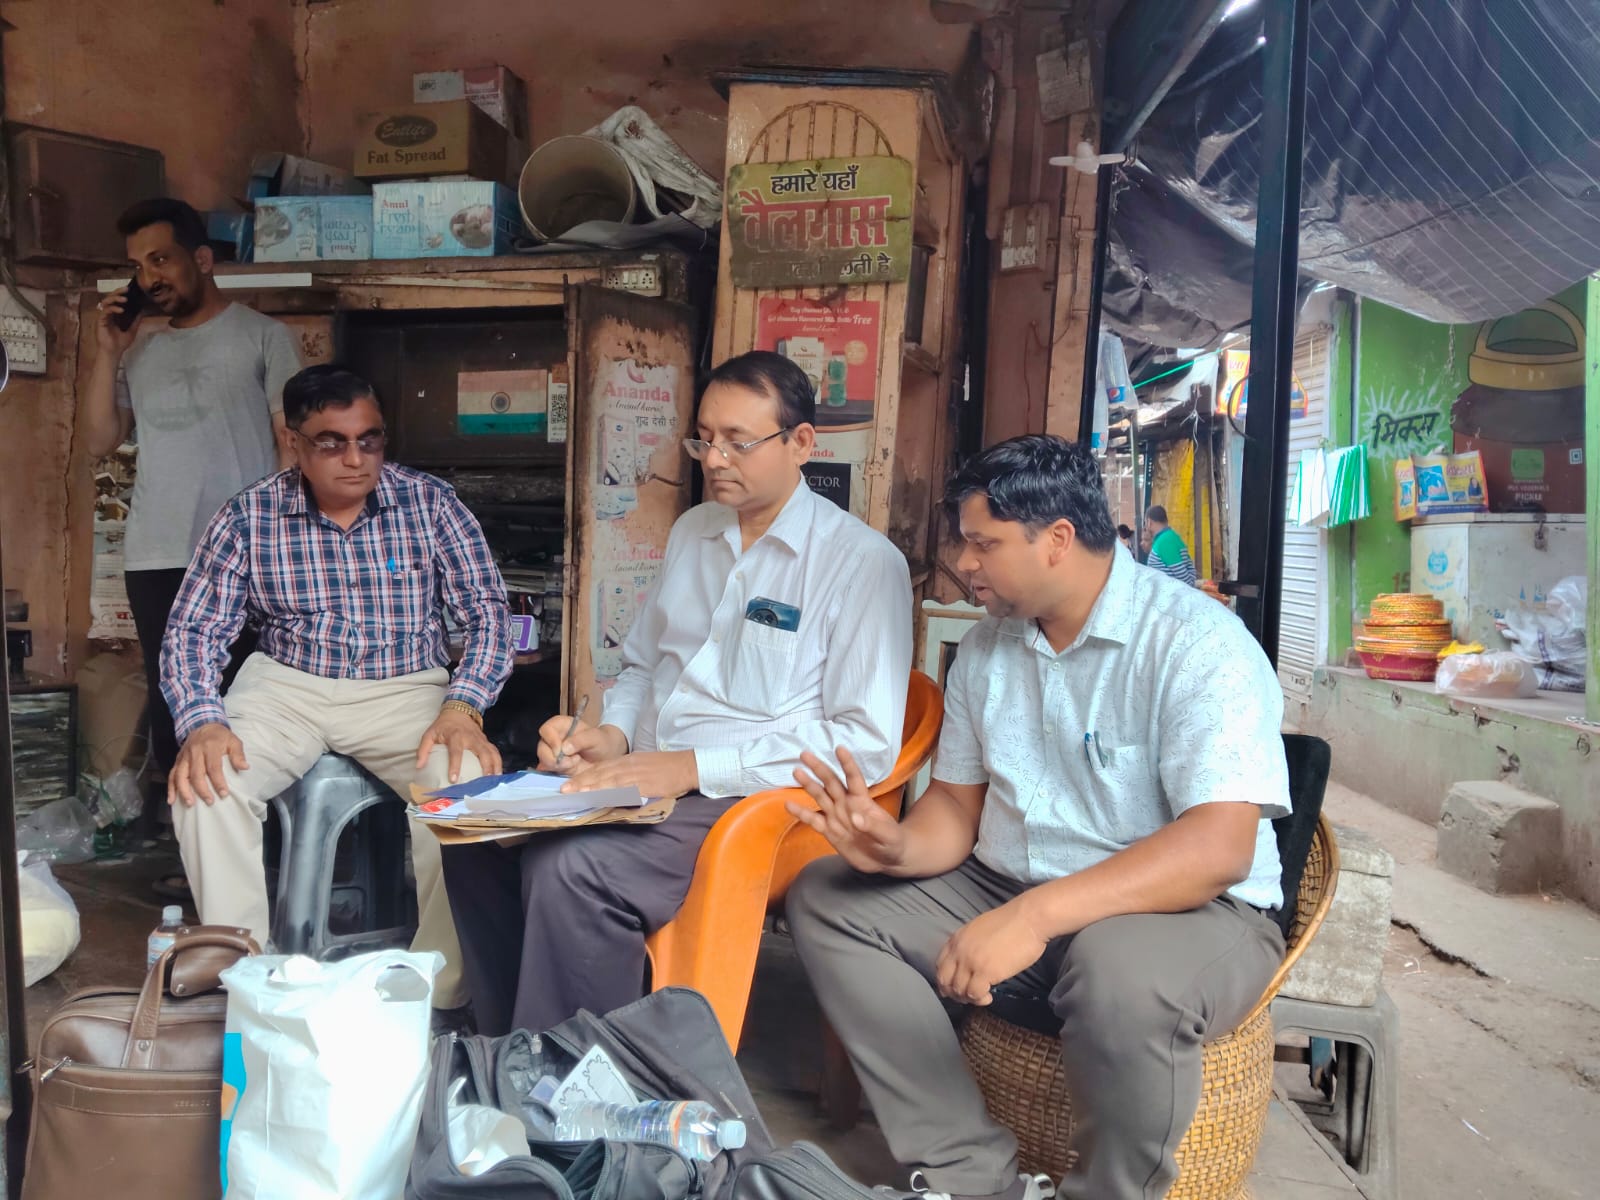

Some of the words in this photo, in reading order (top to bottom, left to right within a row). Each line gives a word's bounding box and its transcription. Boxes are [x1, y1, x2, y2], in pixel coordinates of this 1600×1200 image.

[368, 150, 389, 164] Fat
[394, 147, 447, 165] Spread
[771, 169, 819, 194] हमारे
[822, 165, 859, 190] यहाँ
[382, 199, 409, 209] Amul
[853, 314, 872, 325] Free
[603, 381, 671, 402] Ananda
